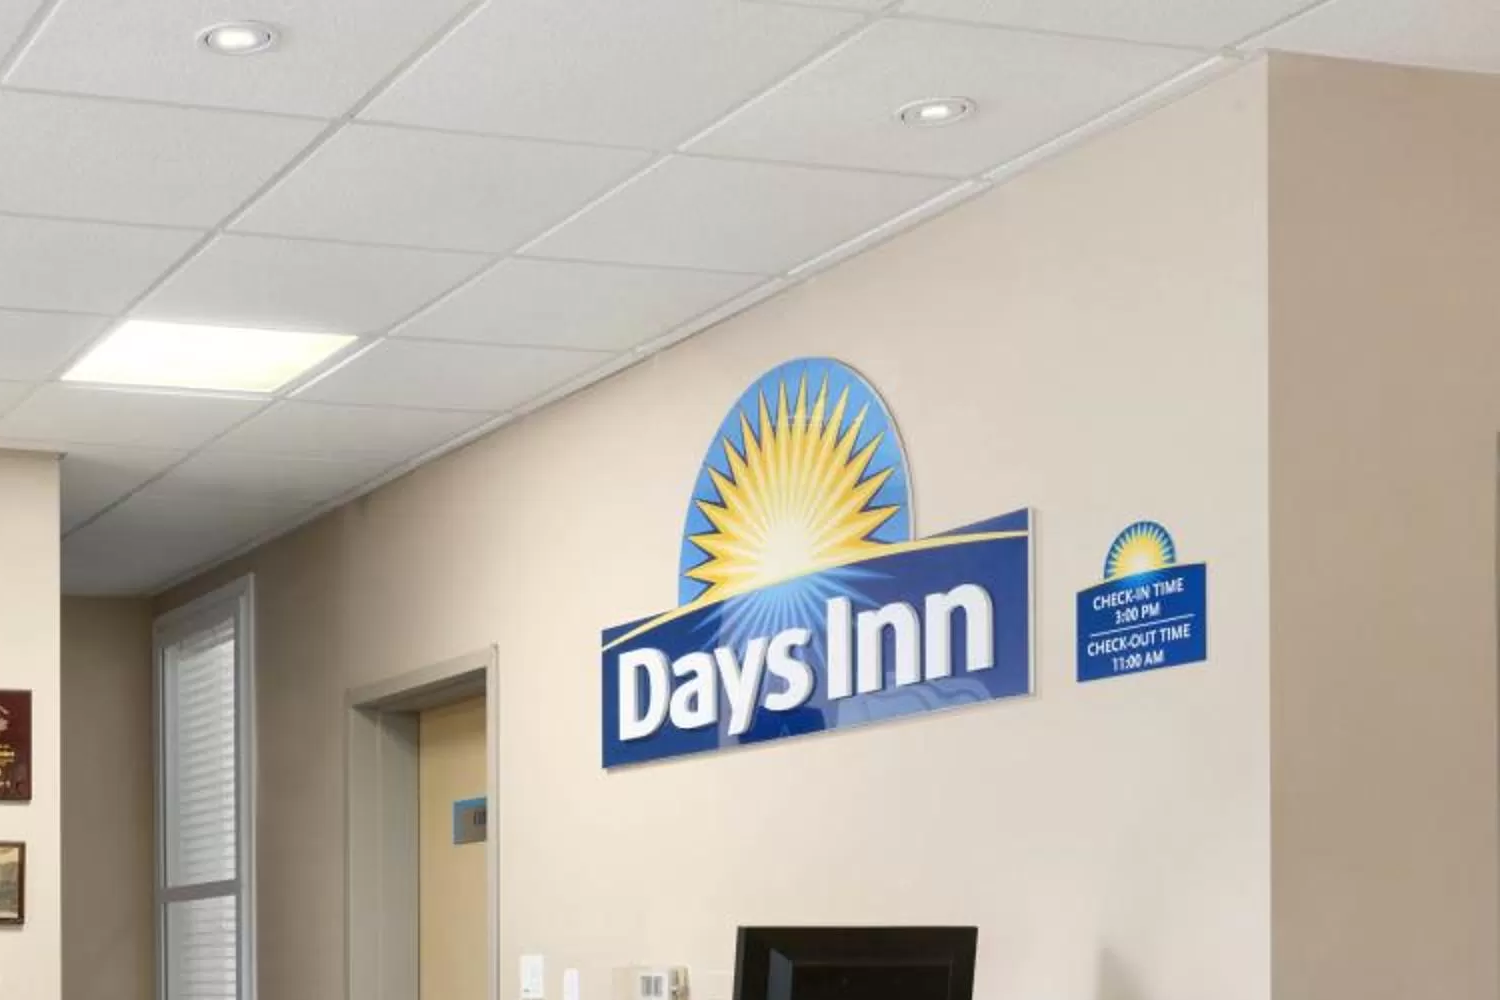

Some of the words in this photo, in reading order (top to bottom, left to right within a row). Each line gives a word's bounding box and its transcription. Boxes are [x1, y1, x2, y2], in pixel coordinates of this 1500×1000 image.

[1093, 584, 1151, 611] CHECK-IN
[1152, 577, 1184, 597] TIME
[1115, 606, 1139, 625] 3:00
[1141, 602, 1160, 619] PM
[1087, 629, 1157, 656] CHECK-OUT
[1159, 623, 1191, 642] TIME
[619, 627, 814, 741] Days
[827, 583, 995, 700] Inn
[1112, 653, 1142, 672] 11:00
[1143, 650, 1164, 666] AM
